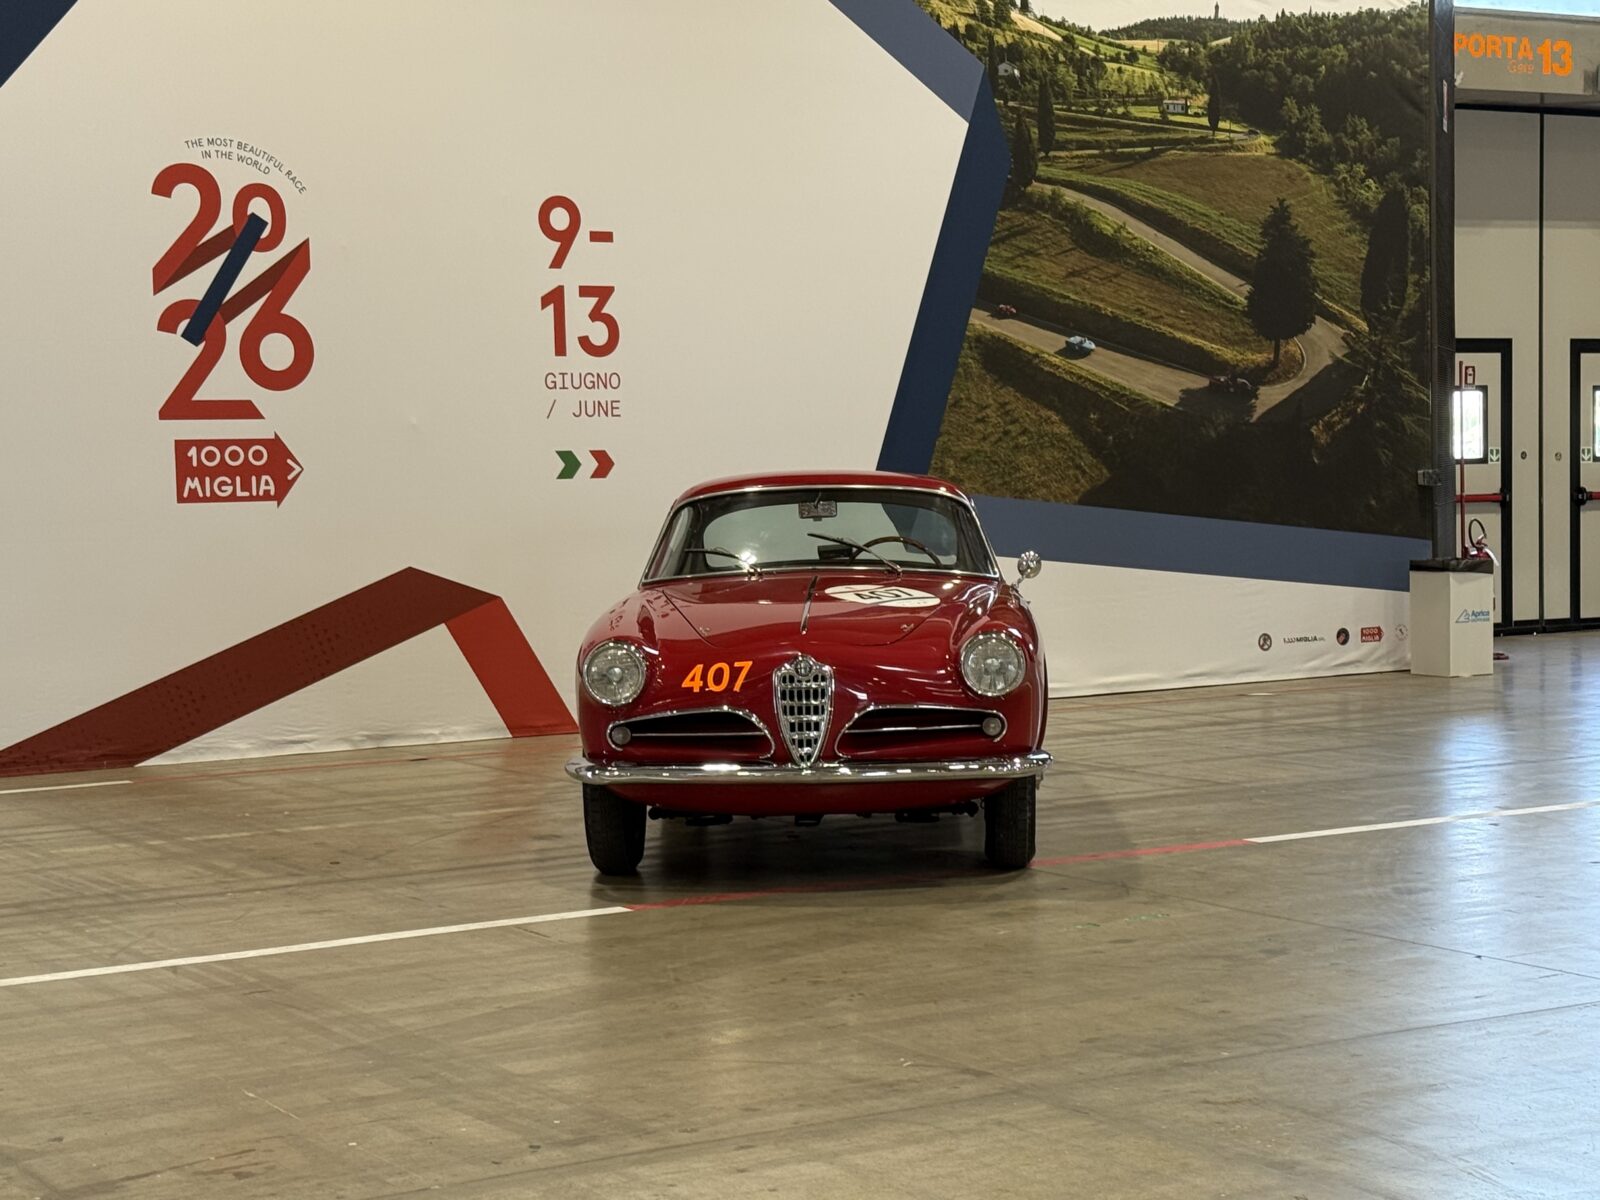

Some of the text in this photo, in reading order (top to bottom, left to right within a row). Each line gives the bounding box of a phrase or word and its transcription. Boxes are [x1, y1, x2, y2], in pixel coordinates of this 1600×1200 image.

[1454, 32, 1573, 76] PORTA 13
[185, 138, 307, 194] THE MOST BEAUTIFUL RACE
[201, 150, 271, 175] IN THE WORLD
[540, 284, 620, 358] 13
[544, 372, 621, 390] GIUGNO
[572, 400, 621, 418] JUNE
[187, 445, 268, 467] 1000
[183, 475, 275, 498] MIGLIA
[681, 660, 753, 693] 407
